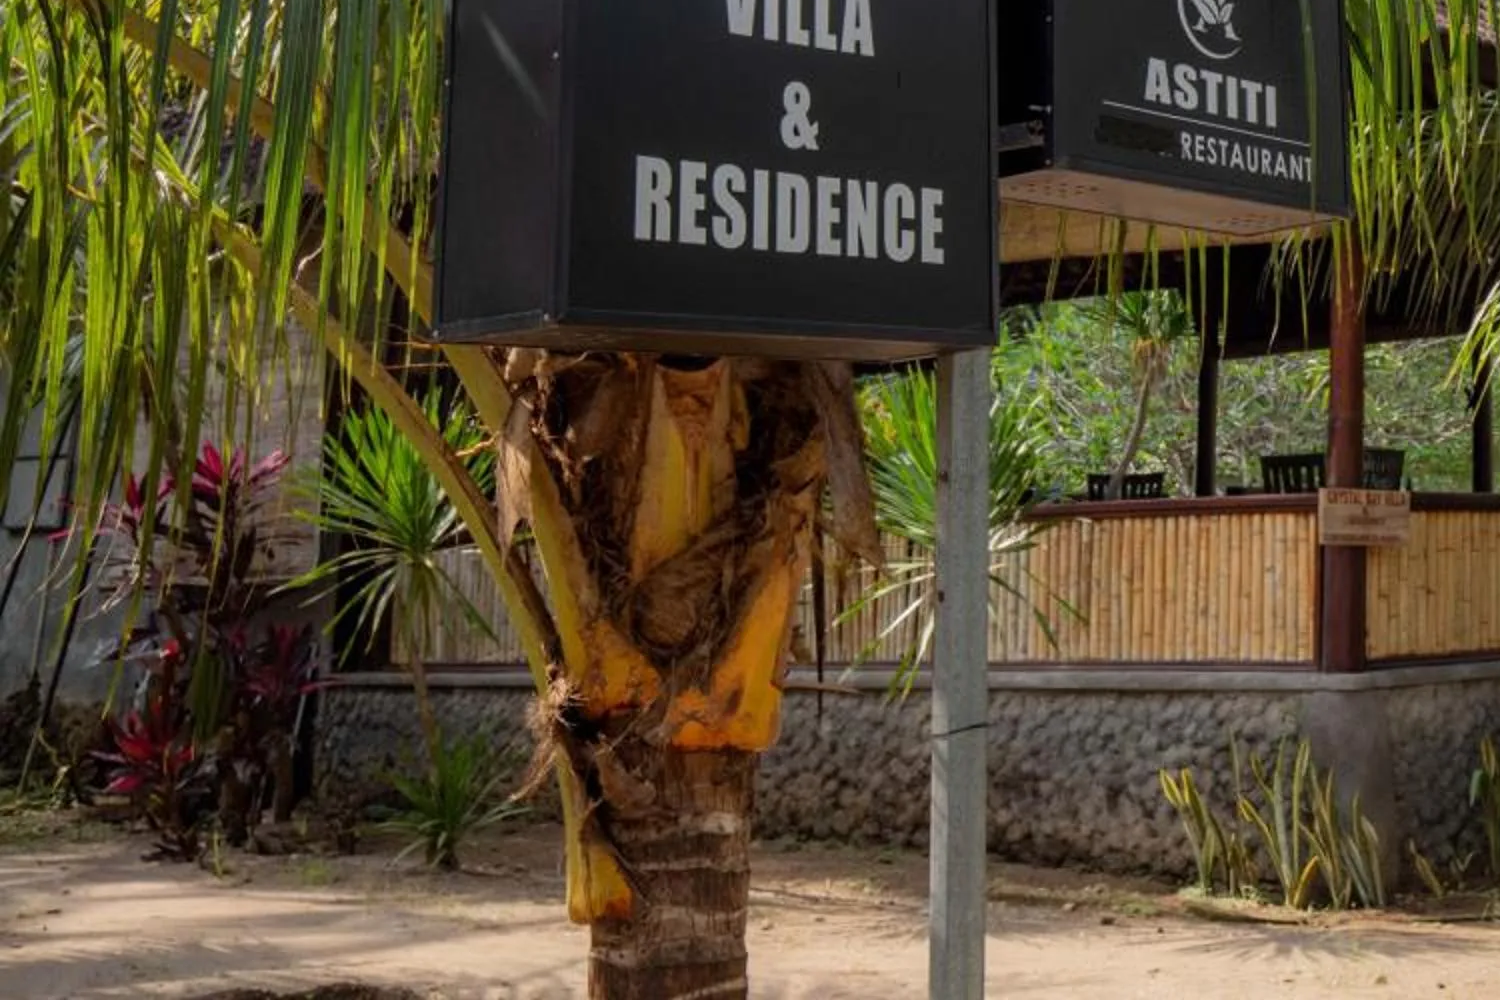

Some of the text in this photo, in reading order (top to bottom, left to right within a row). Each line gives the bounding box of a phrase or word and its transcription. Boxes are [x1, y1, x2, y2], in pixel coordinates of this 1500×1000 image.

[781, 81, 819, 151] &
[1144, 56, 1277, 128] ASTITI
[1180, 131, 1312, 183] RESTAURANT
[634, 155, 945, 264] RESIDENCE
